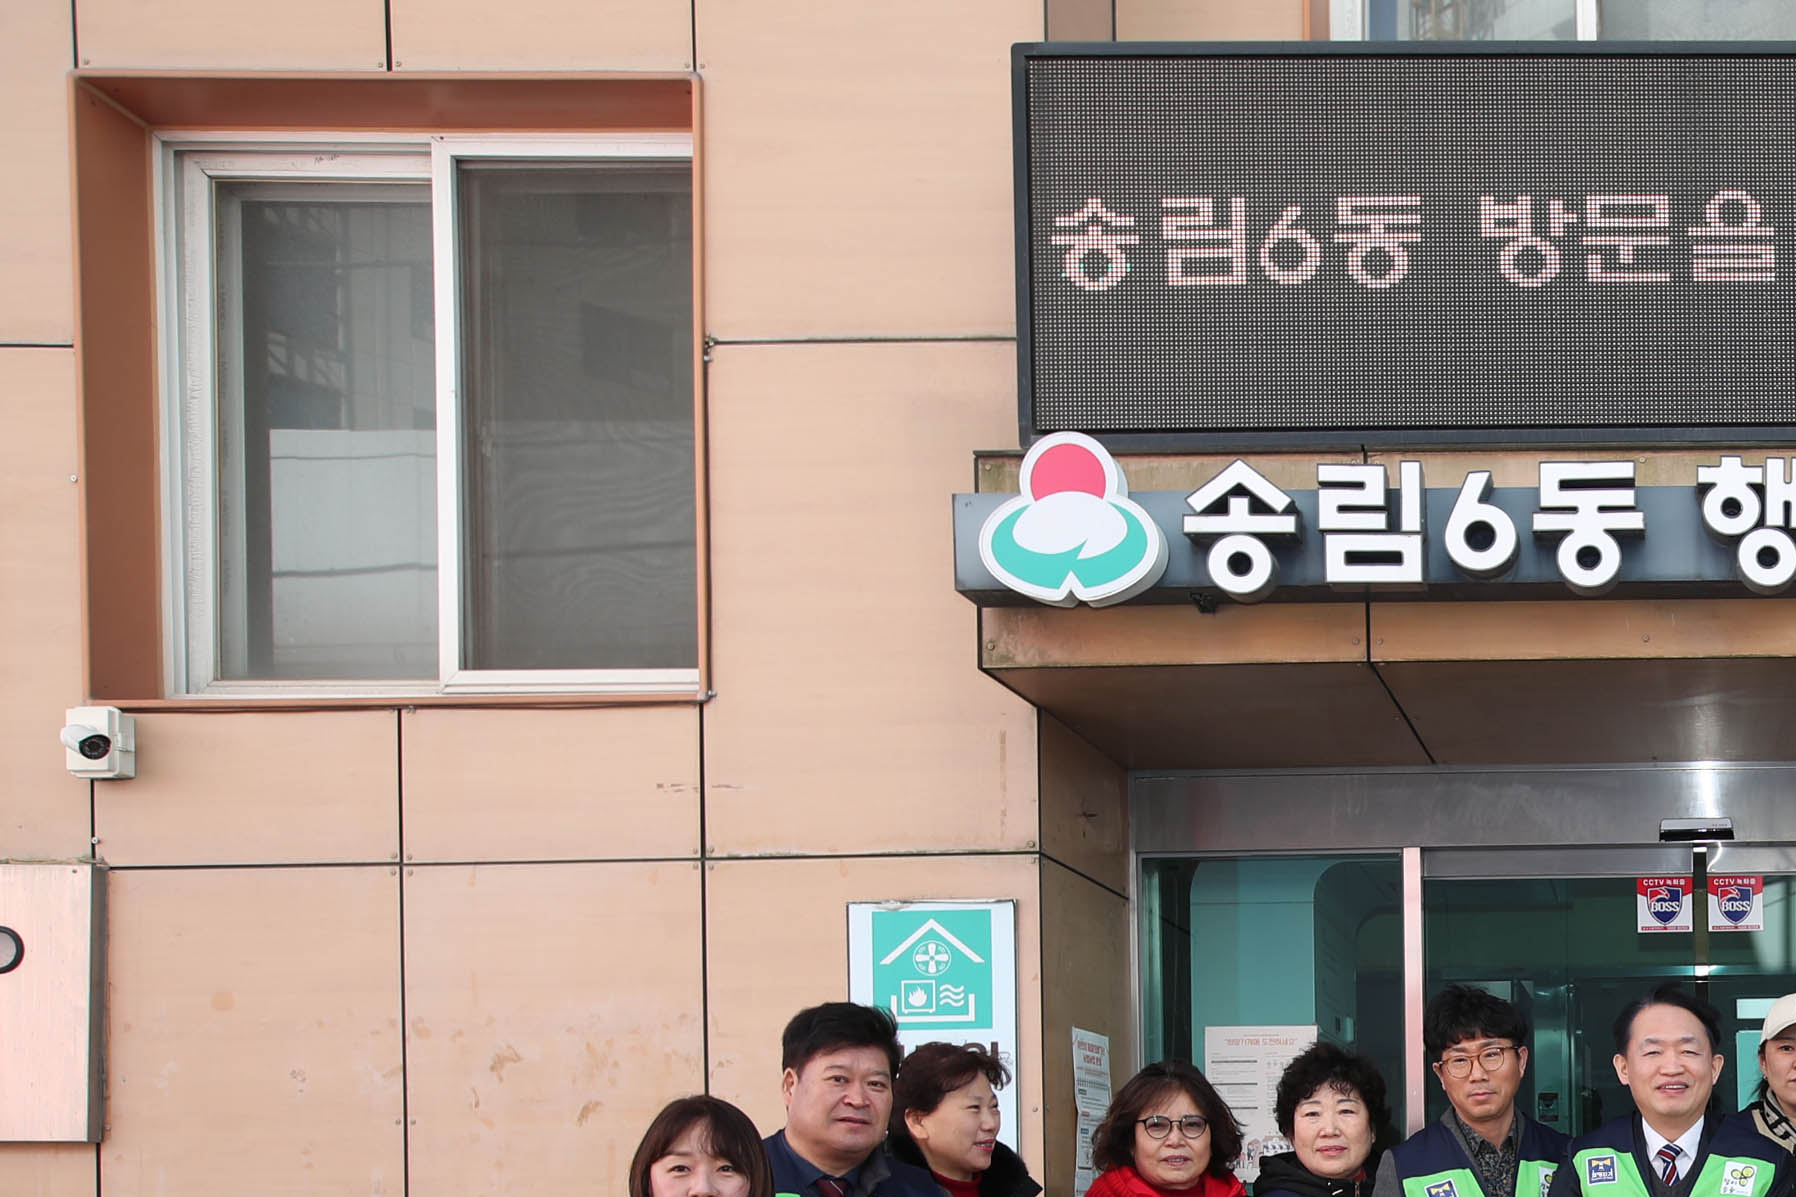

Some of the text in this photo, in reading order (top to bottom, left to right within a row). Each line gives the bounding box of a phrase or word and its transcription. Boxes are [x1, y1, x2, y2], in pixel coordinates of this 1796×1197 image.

[1050, 195, 1422, 291] 송림6동
[1480, 189, 1776, 289] 방문을
[1181, 457, 1646, 596] 송림6동
[1651, 901, 1680, 912] BOSS
[1722, 901, 1751, 912] BOSS
